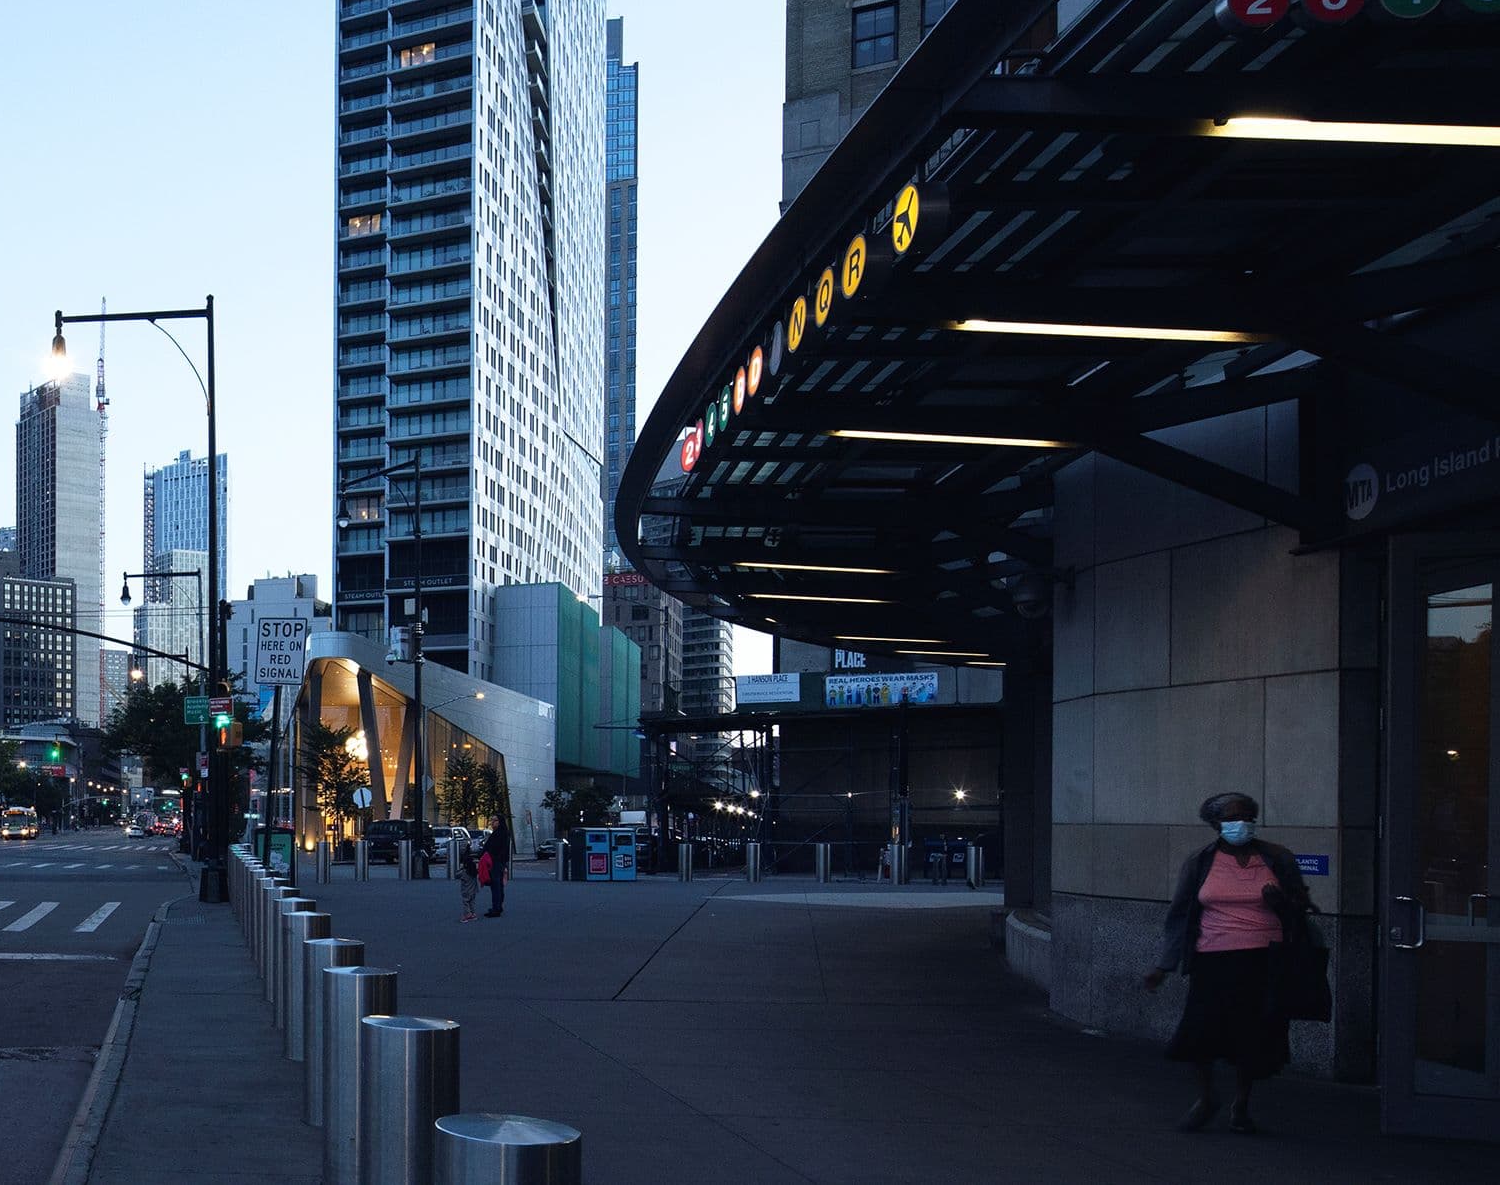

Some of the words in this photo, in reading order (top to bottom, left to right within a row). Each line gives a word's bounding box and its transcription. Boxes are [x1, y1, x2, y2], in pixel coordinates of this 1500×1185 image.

[684, 440, 695, 466] 2
[708, 412, 714, 437] 4
[722, 394, 728, 421] 5
[752, 357, 761, 387] D
[792, 307, 803, 339] N
[819, 279, 830, 313] Q
[848, 248, 861, 287] R
[1386, 465, 1430, 493] Long
[1433, 440, 1490, 478] Island
[426, 578, 453, 586] OUTLET
[261, 622, 304, 637] STOP
[261, 640, 285, 651] HERE
[289, 640, 302, 651] ON
[270, 654, 291, 665] RED
[835, 648, 867, 668] PLACE
[260, 667, 300, 679] SIGNAL
[751, 675, 773, 683] HANSON
[773, 674, 789, 683] PLACE
